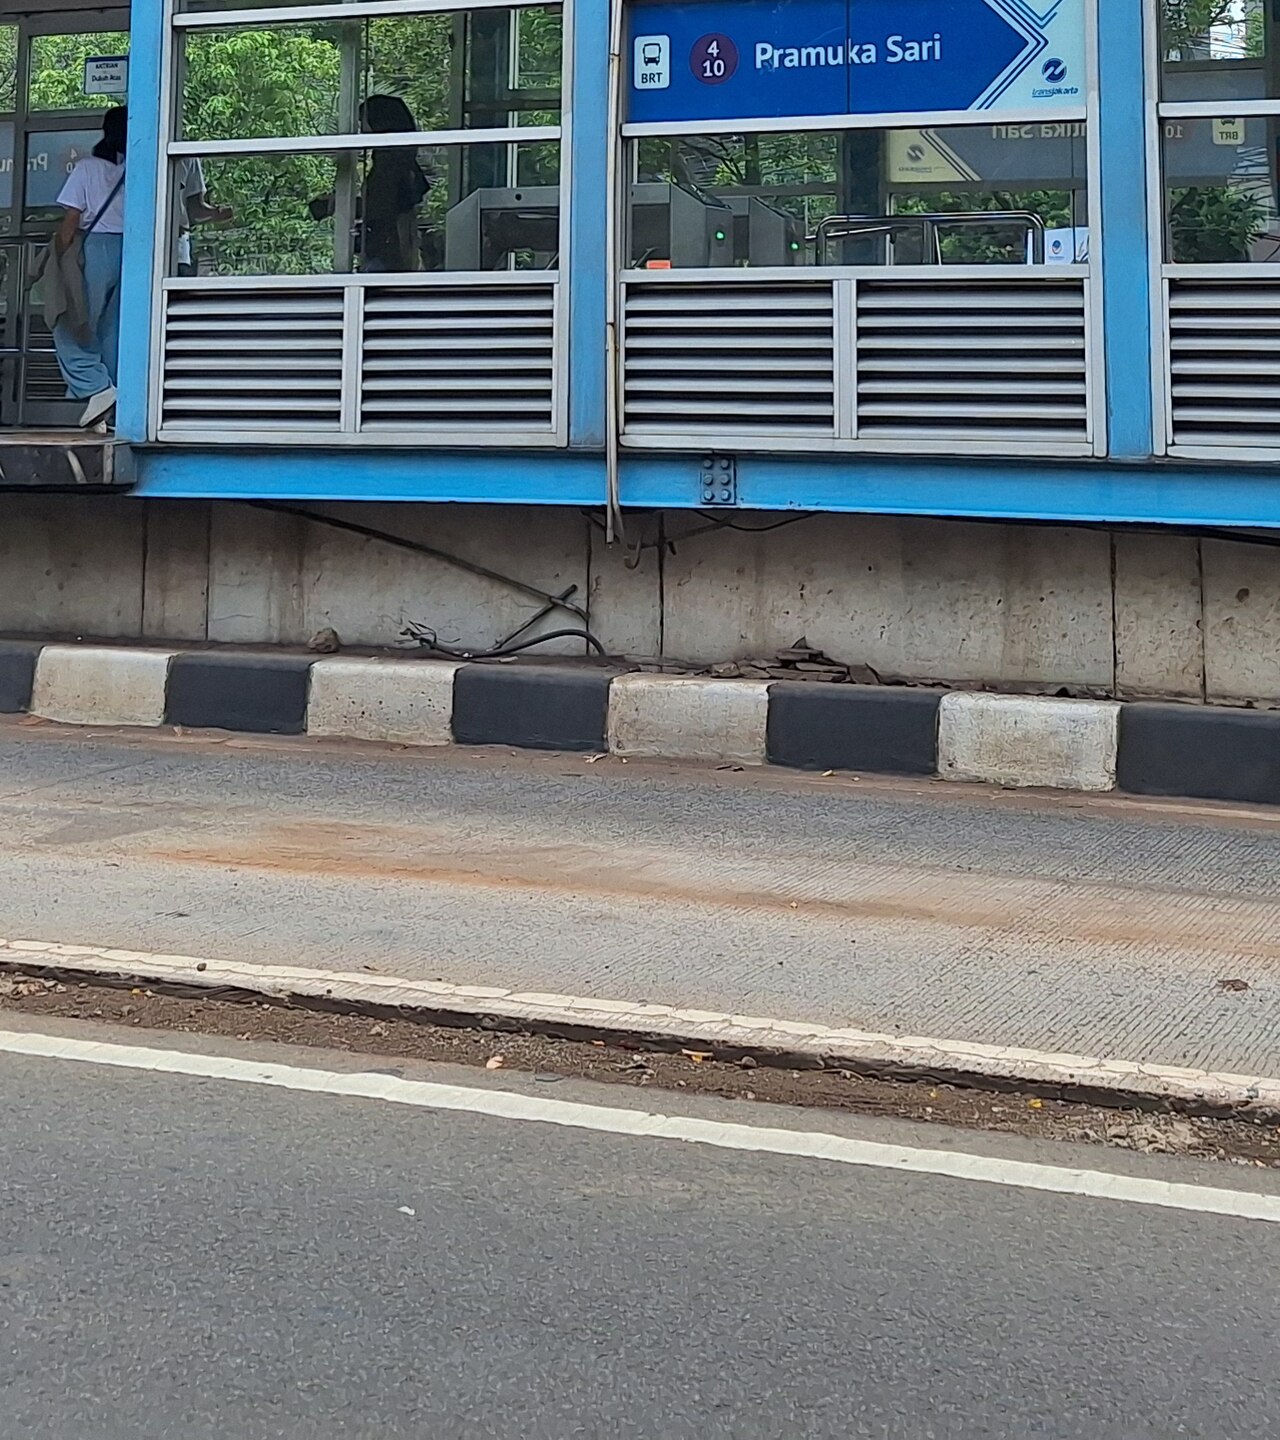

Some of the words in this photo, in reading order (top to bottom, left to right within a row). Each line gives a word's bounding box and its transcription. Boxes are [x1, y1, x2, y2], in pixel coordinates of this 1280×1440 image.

[707, 40, 719, 57] 4
[755, 38, 877, 69] Pramuka
[886, 33, 941, 62] Sari
[702, 60, 725, 77] 10
[641, 72, 663, 84] BRT
